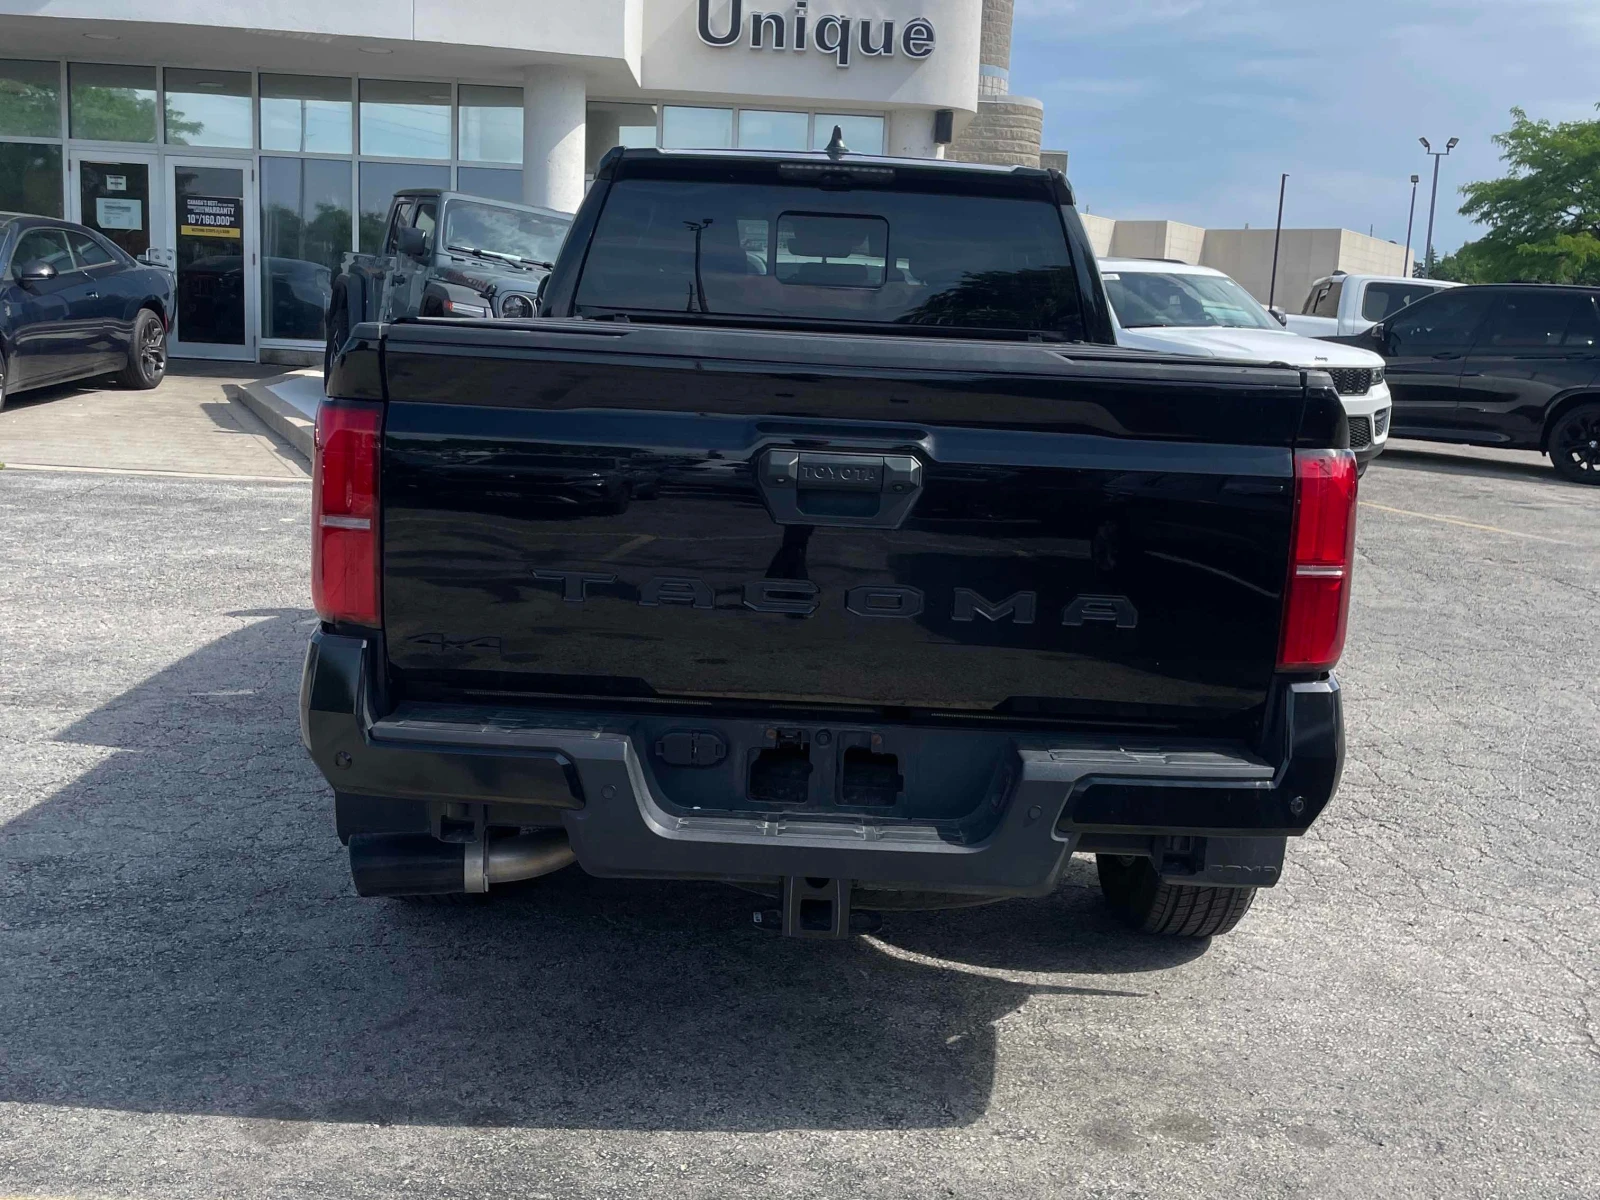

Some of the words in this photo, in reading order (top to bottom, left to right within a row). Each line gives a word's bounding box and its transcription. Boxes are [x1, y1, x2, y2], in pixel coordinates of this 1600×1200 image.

[697, 0, 937, 69] Unique
[204, 206, 234, 214] WARRANTY
[802, 465, 876, 480] TOYOTA
[530, 568, 1139, 629] TACOMA
